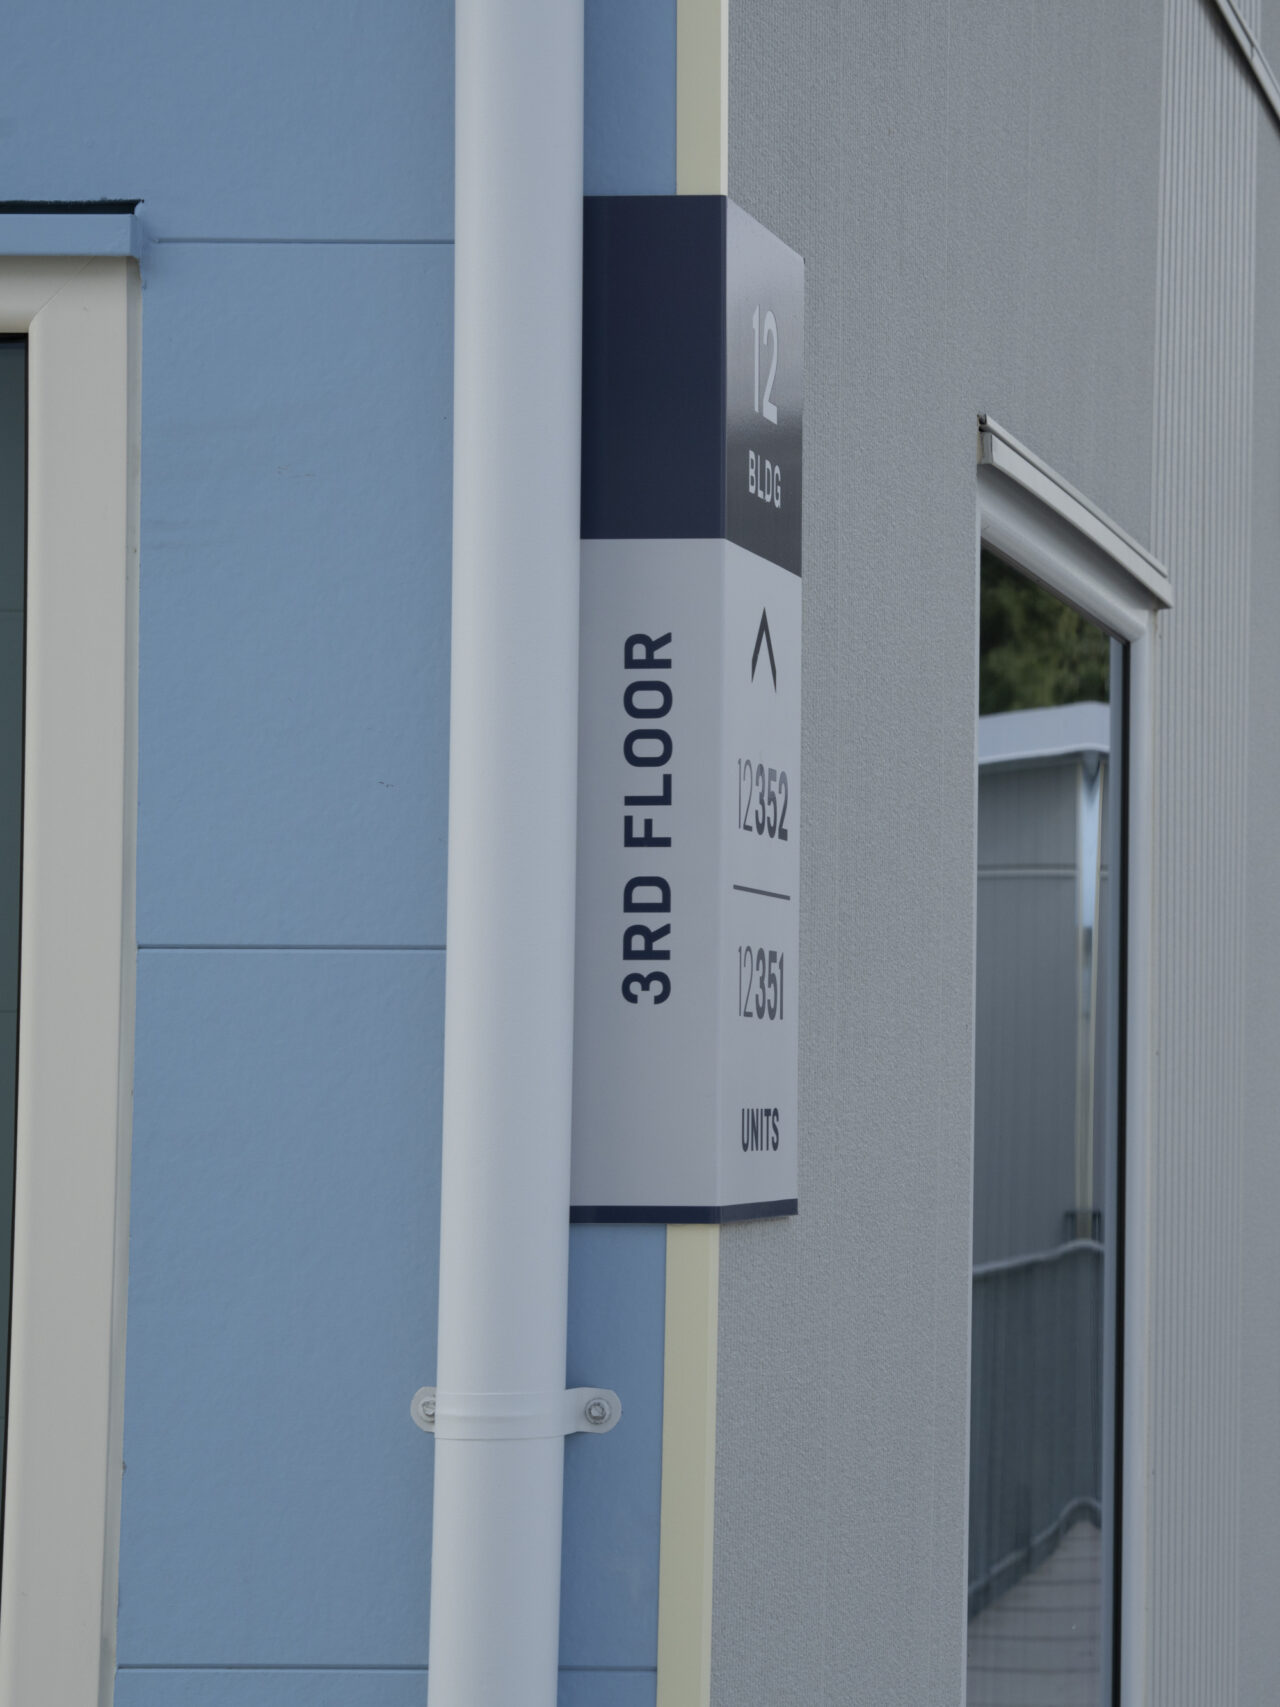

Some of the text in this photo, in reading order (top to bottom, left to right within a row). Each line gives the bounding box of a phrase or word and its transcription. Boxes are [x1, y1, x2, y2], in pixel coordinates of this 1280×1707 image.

[752, 304, 778, 425] 12
[749, 449, 781, 508] BLDG
[621, 631, 673, 1005] 3RD FLOOR
[737, 757, 789, 842] 12352
[737, 945, 784, 1021] 12351
[741, 1107, 780, 1153] UNITS
